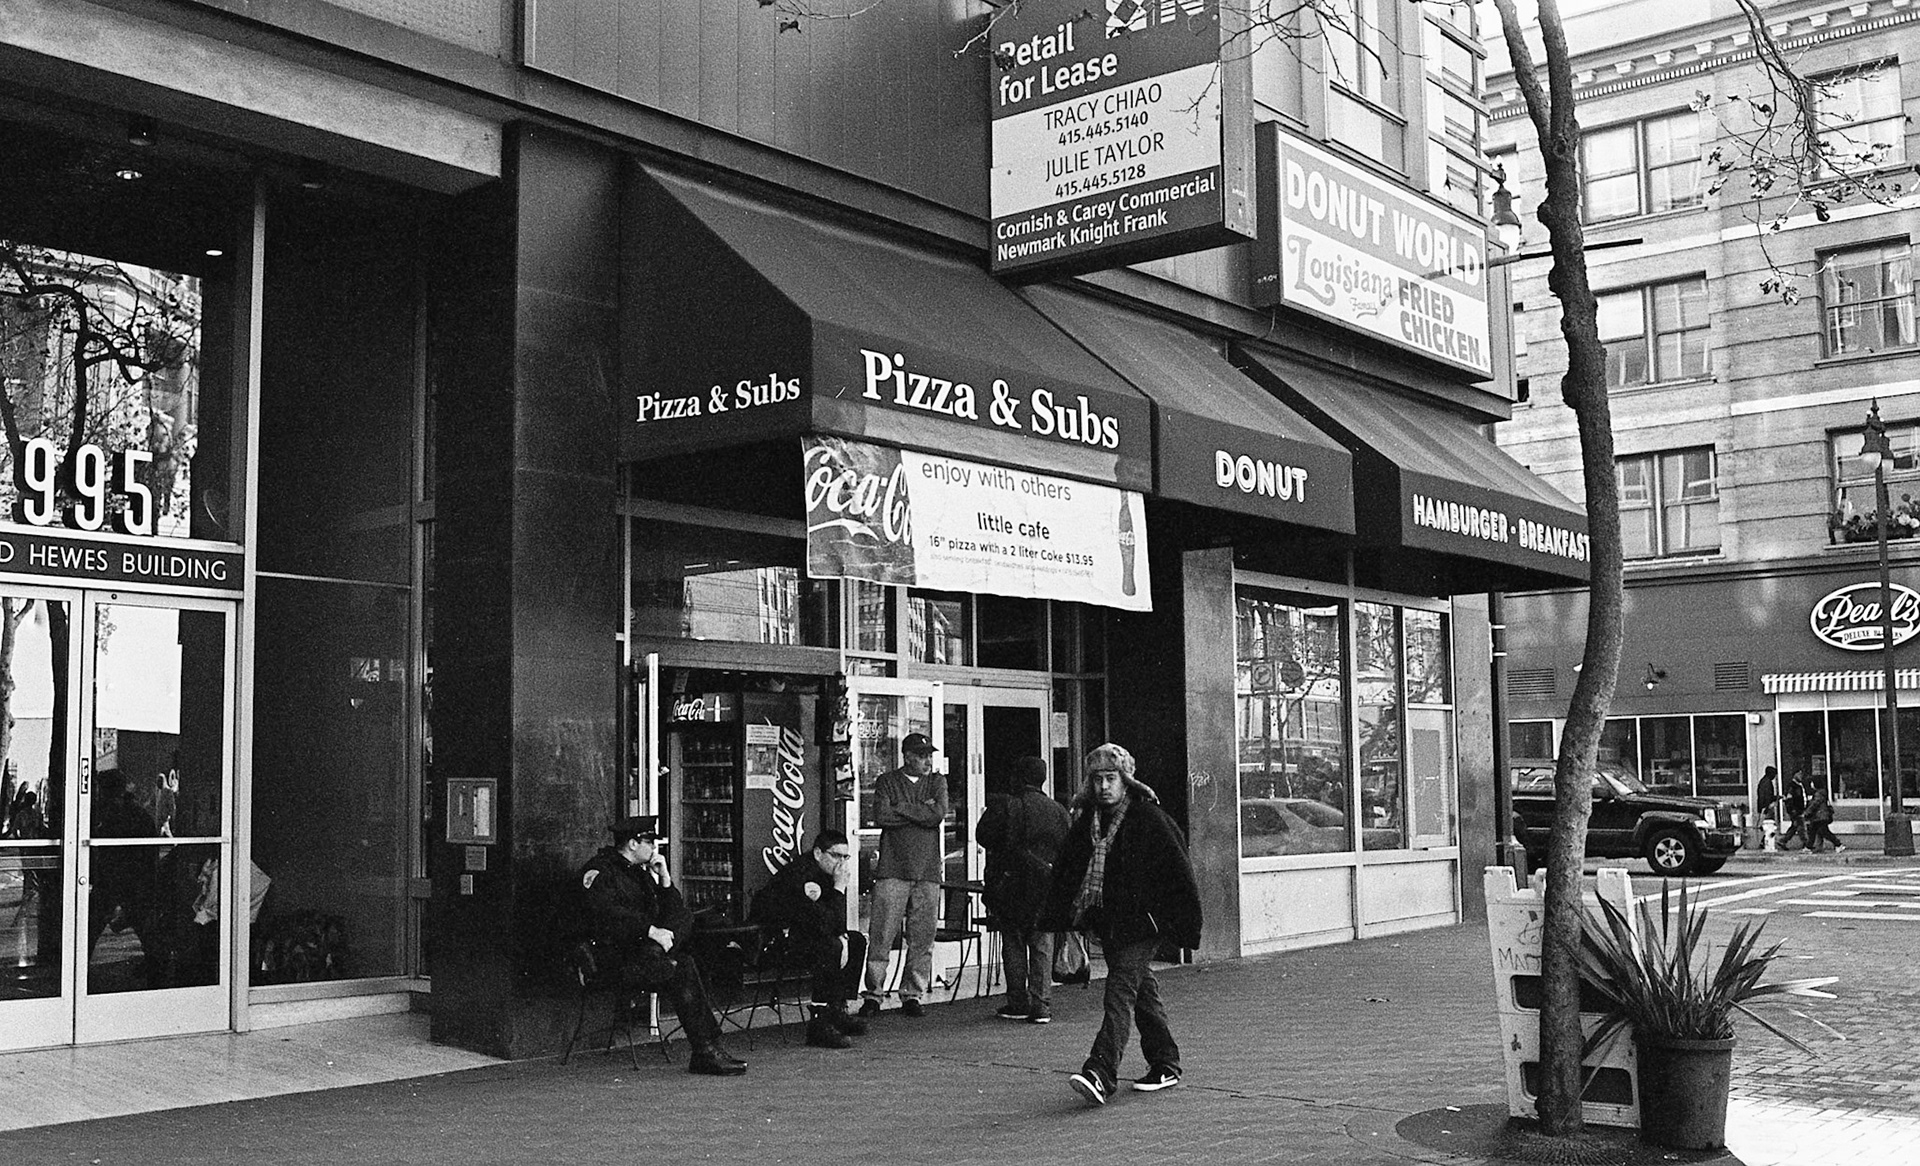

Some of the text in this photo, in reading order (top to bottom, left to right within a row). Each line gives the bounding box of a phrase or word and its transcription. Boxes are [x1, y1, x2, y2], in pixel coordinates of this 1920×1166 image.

[999, 53, 1118, 106] for Lease
[1044, 83, 1162, 131] TRACY CHIAO
[1058, 111, 1148, 146] 415.445.5140
[1045, 132, 1165, 182] JULIE TAYLOR
[1055, 164, 1146, 198] 415.445.5128
[996, 172, 1216, 240] Cornish & Carey Commercial
[1286, 158, 1480, 286] DONUT WORLD
[998, 208, 1168, 262] Newmark Knight Frank
[1287, 234, 1393, 306] Louisiana
[1399, 276, 1455, 325] FRIED
[1400, 310, 1482, 367] CHICKEN
[636, 372, 800, 423] Pizza & Subs
[860, 348, 1120, 450] Pizza & Subs
[23, 437, 154, 536] 995
[921, 460, 1072, 502] enjoy with others
[1215, 449, 1308, 503] DONUT
[977, 512, 1051, 540] little cafe
[1413, 493, 1591, 563] HAMBURGER BREAKFAST
[29, 543, 109, 572] HEWES
[122, 552, 227, 581] BUILDING
[949, 539, 976, 552] pizza
[980, 542, 1000, 555] with
[1002, 546, 1008, 556] a
[1010, 545, 1016, 556] 2
[1019, 546, 1038, 559] liter
[1041, 549, 1064, 563] Coke
[1066, 553, 1094, 566] $13.95
[1817, 592, 1920, 634] Peal's
[1844, 630, 1870, 641] DELUXE
